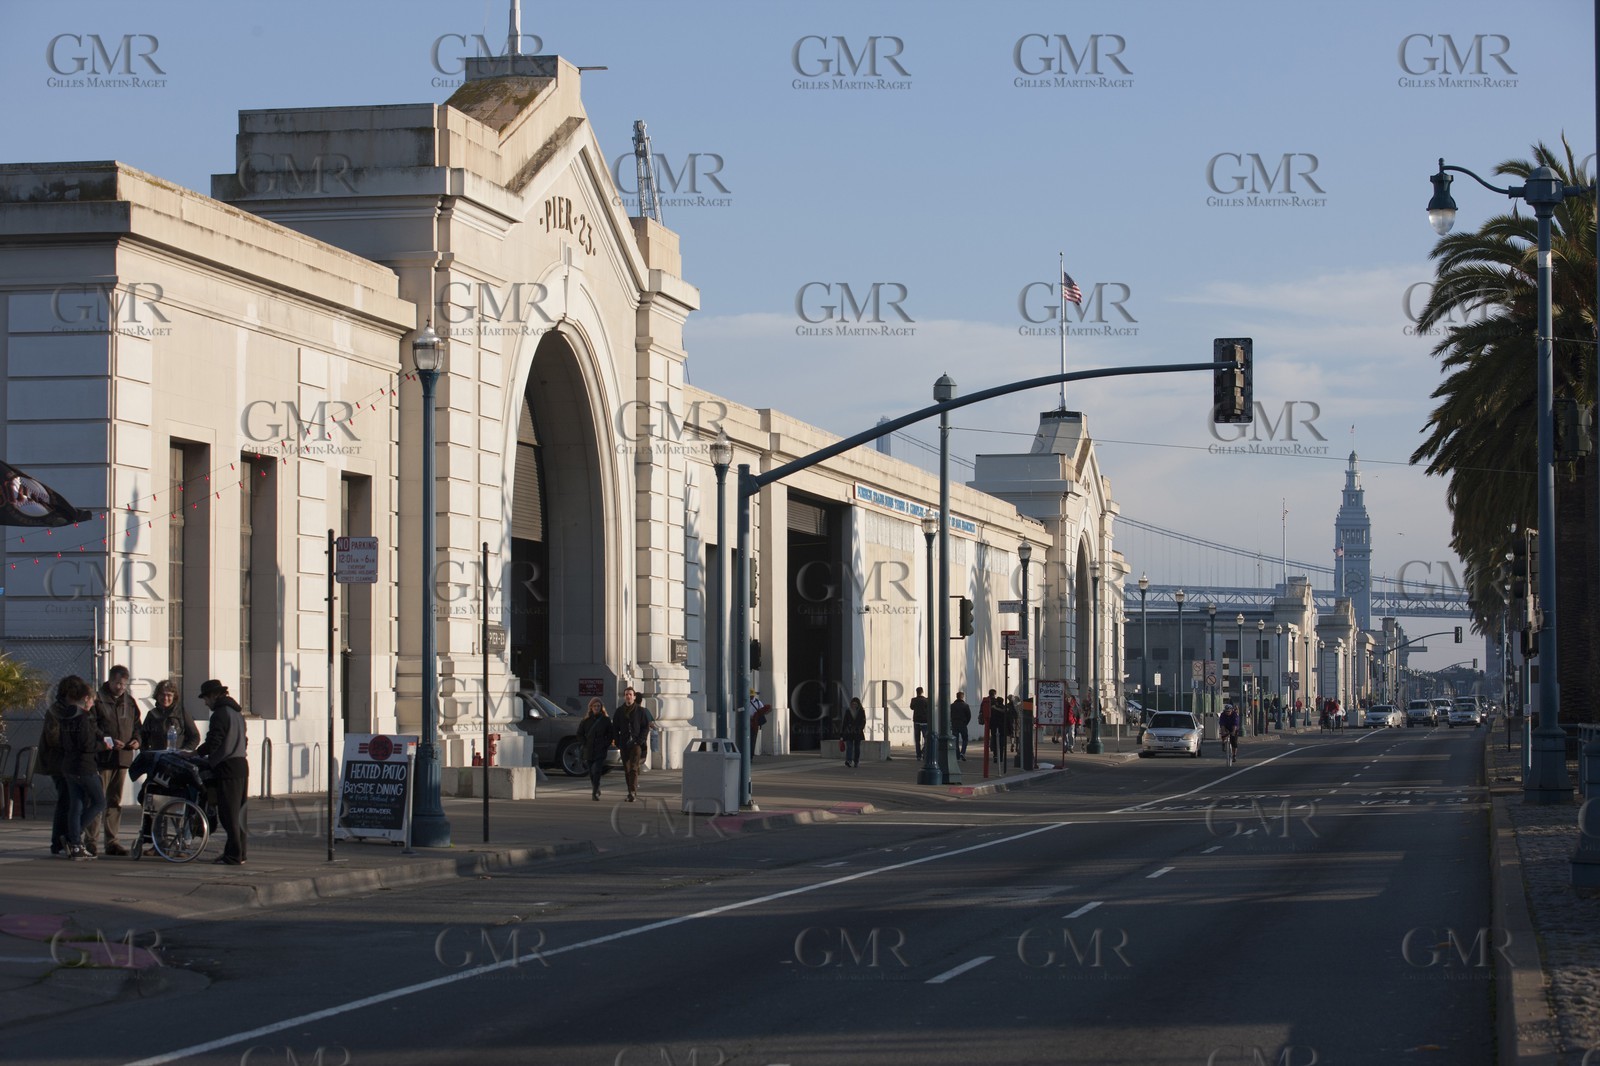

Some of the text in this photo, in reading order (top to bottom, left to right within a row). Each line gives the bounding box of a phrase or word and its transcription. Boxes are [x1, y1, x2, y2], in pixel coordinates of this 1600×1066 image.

[338, 538, 376, 550] NO PARKING
[350, 763, 407, 781] HEATED PATIO
[376, 783, 403, 796] DINING
